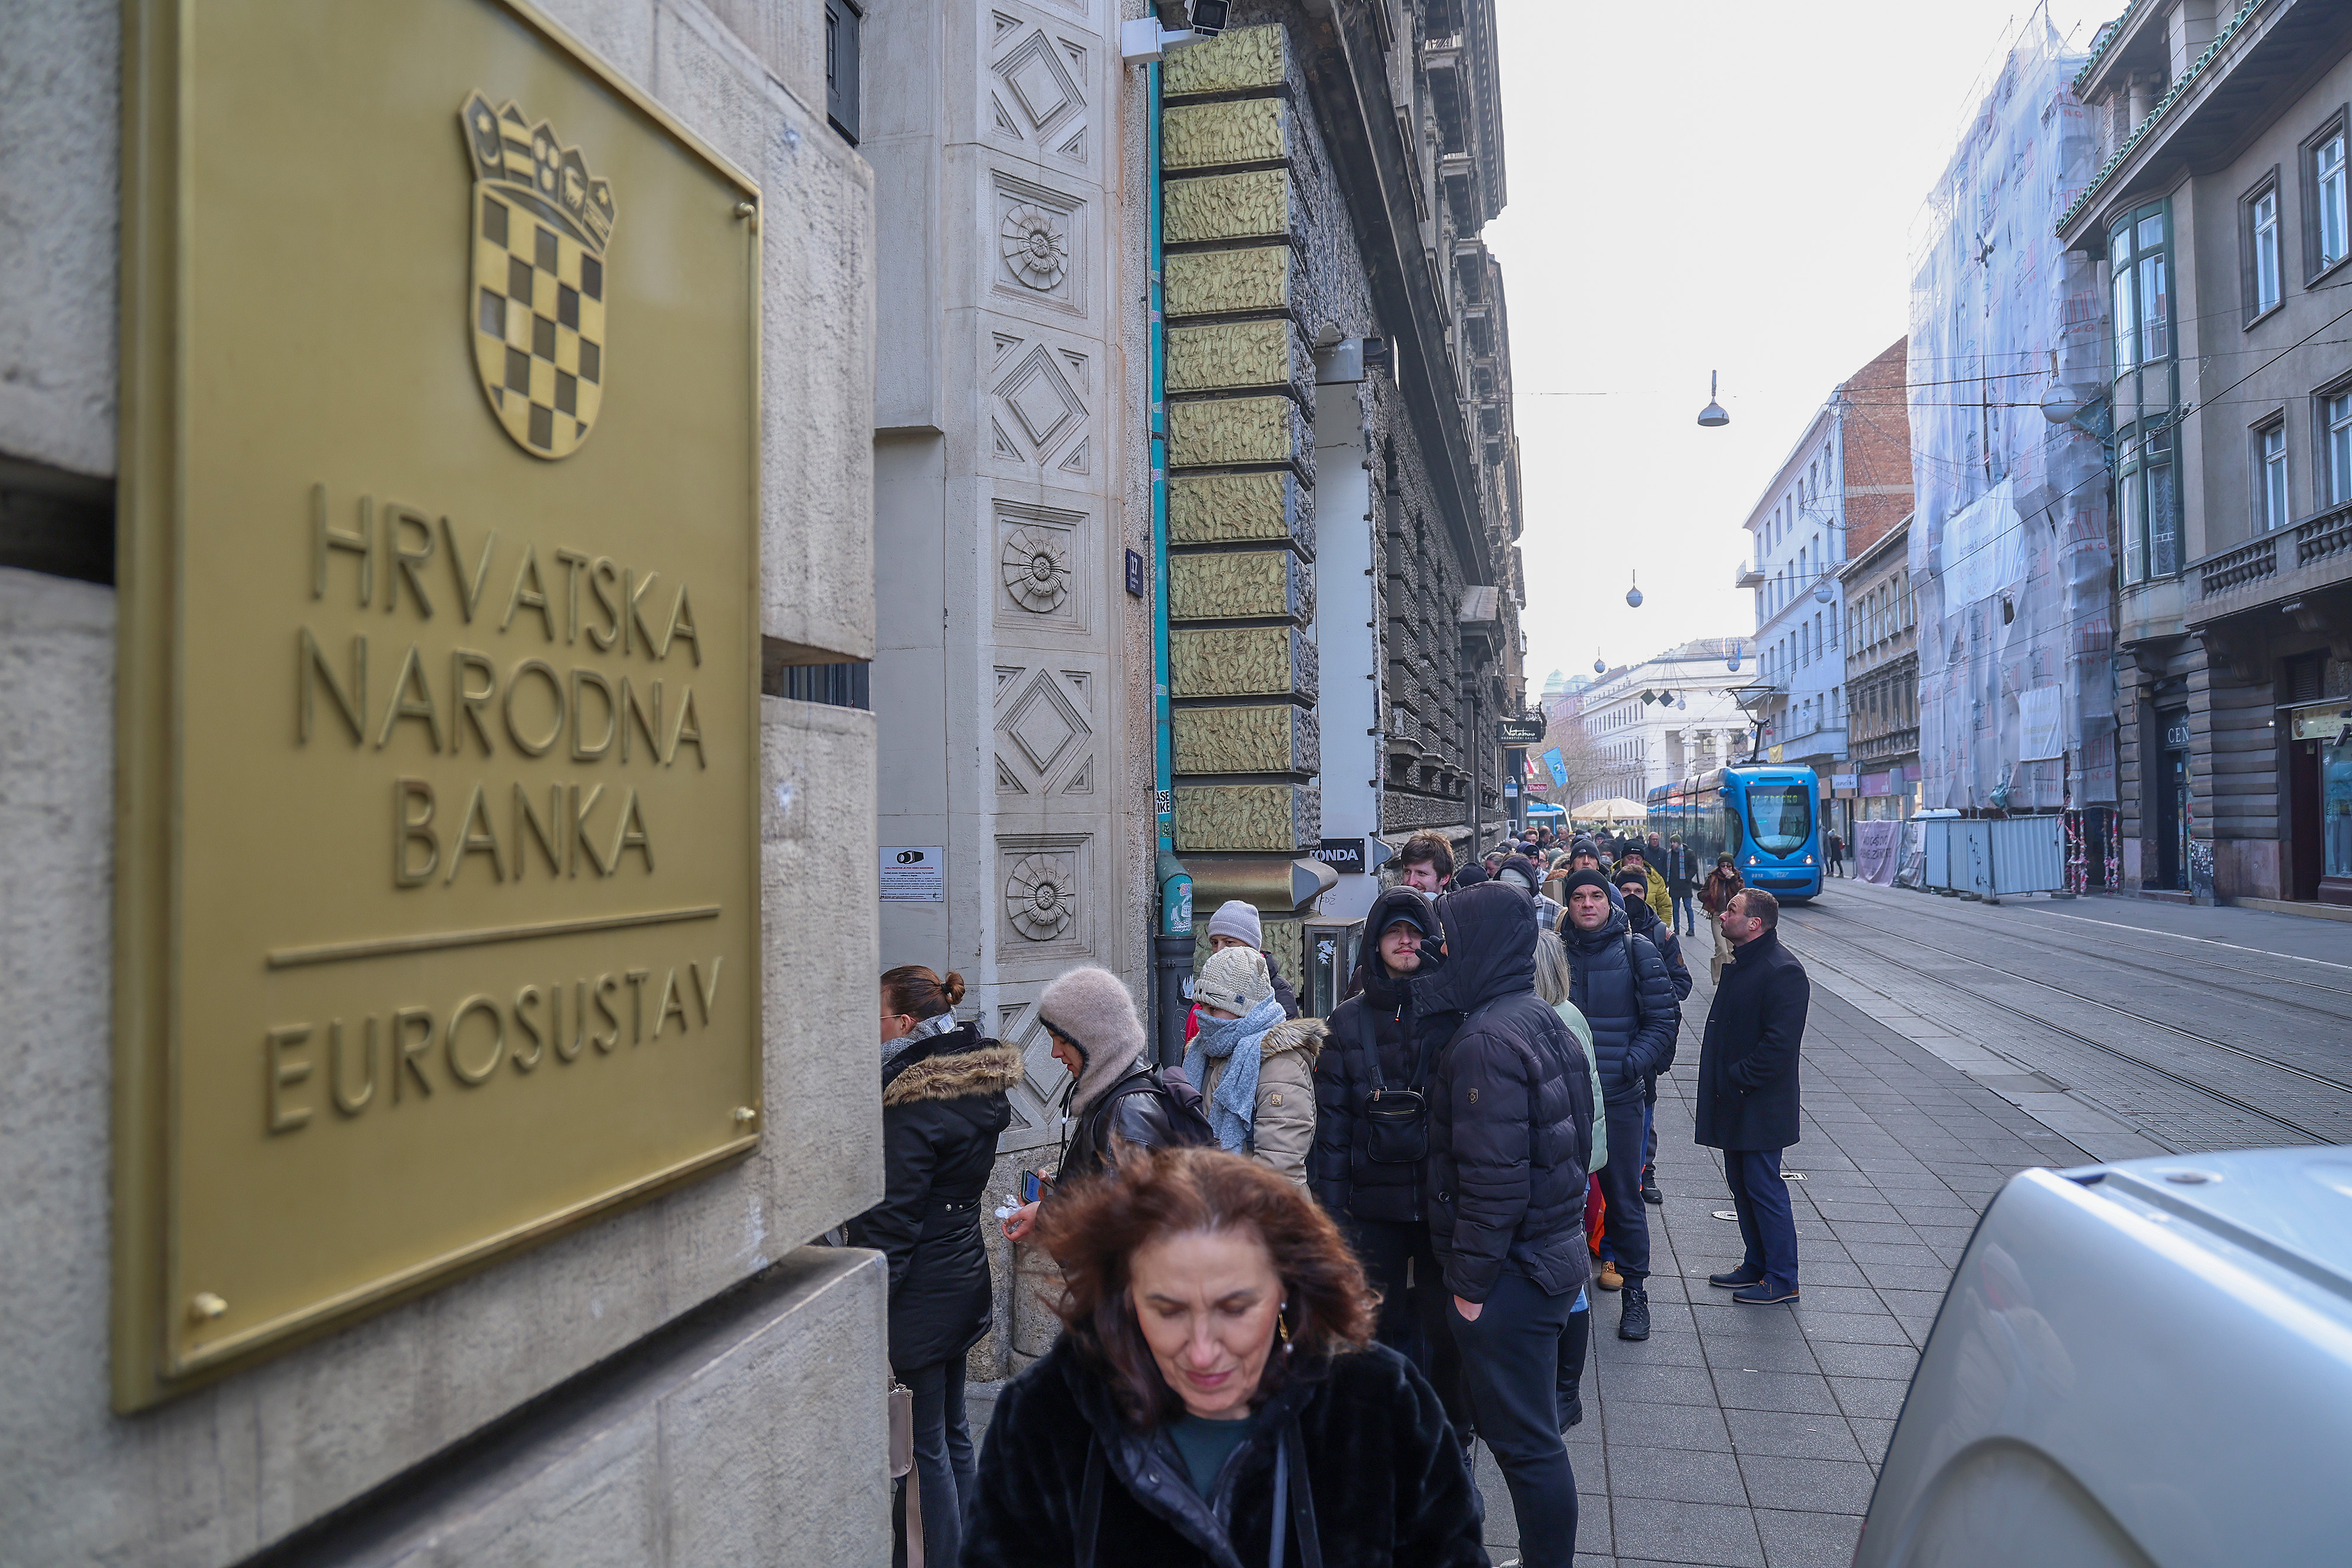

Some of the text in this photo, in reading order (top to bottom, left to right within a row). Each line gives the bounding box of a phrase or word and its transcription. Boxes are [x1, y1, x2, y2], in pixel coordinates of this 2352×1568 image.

[313, 483, 701, 667] HRVATSKA
[1131, 556, 1138, 575] 17
[298, 625, 706, 768] NARODNA
[2168, 727, 2189, 743] CEN
[395, 775, 654, 890] BANKA
[1157, 801, 1170, 813] IKE
[268, 956, 724, 1135] EUROSUSTAV
